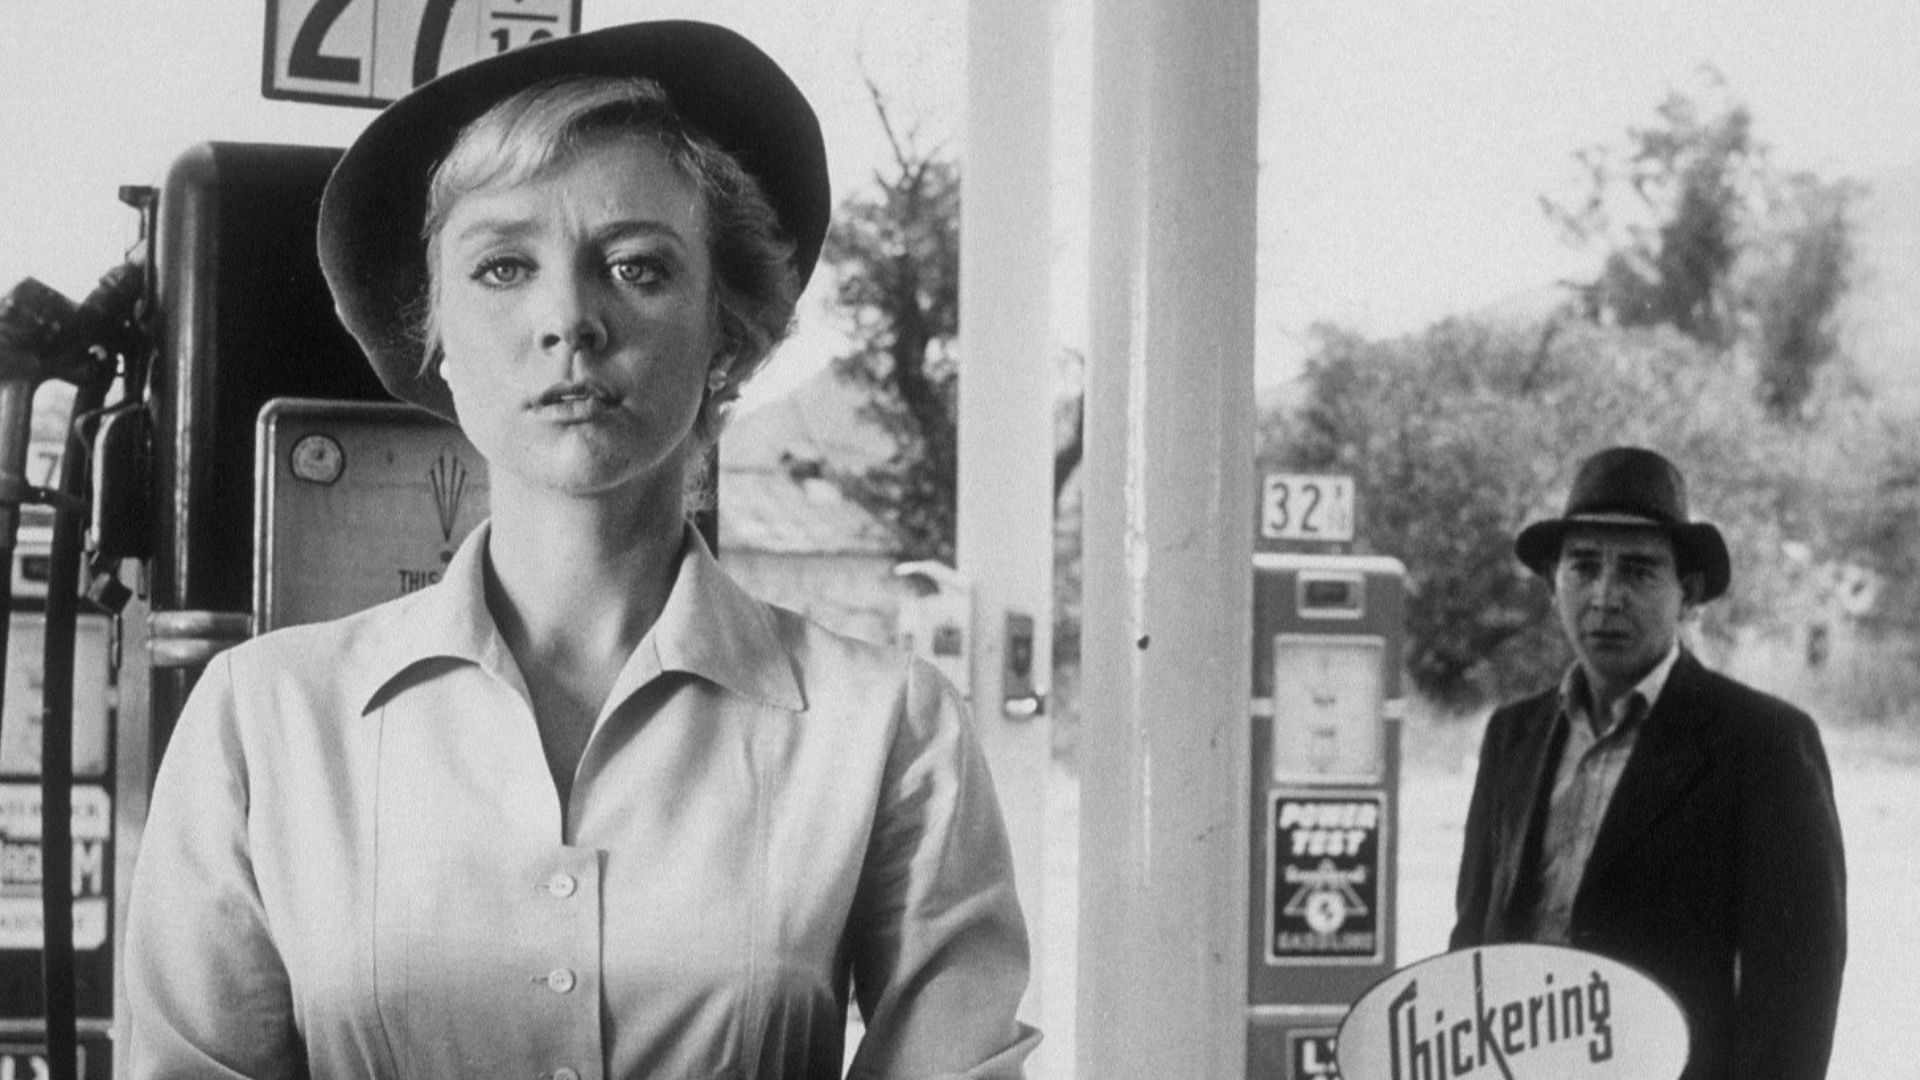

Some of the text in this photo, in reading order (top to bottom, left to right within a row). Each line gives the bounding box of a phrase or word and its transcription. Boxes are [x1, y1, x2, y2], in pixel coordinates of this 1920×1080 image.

[1271, 482, 1320, 532] 32
[1279, 802, 1378, 830] POWER
[1291, 829, 1368, 857] TEST
[1388, 951, 1613, 1080] Chickering
